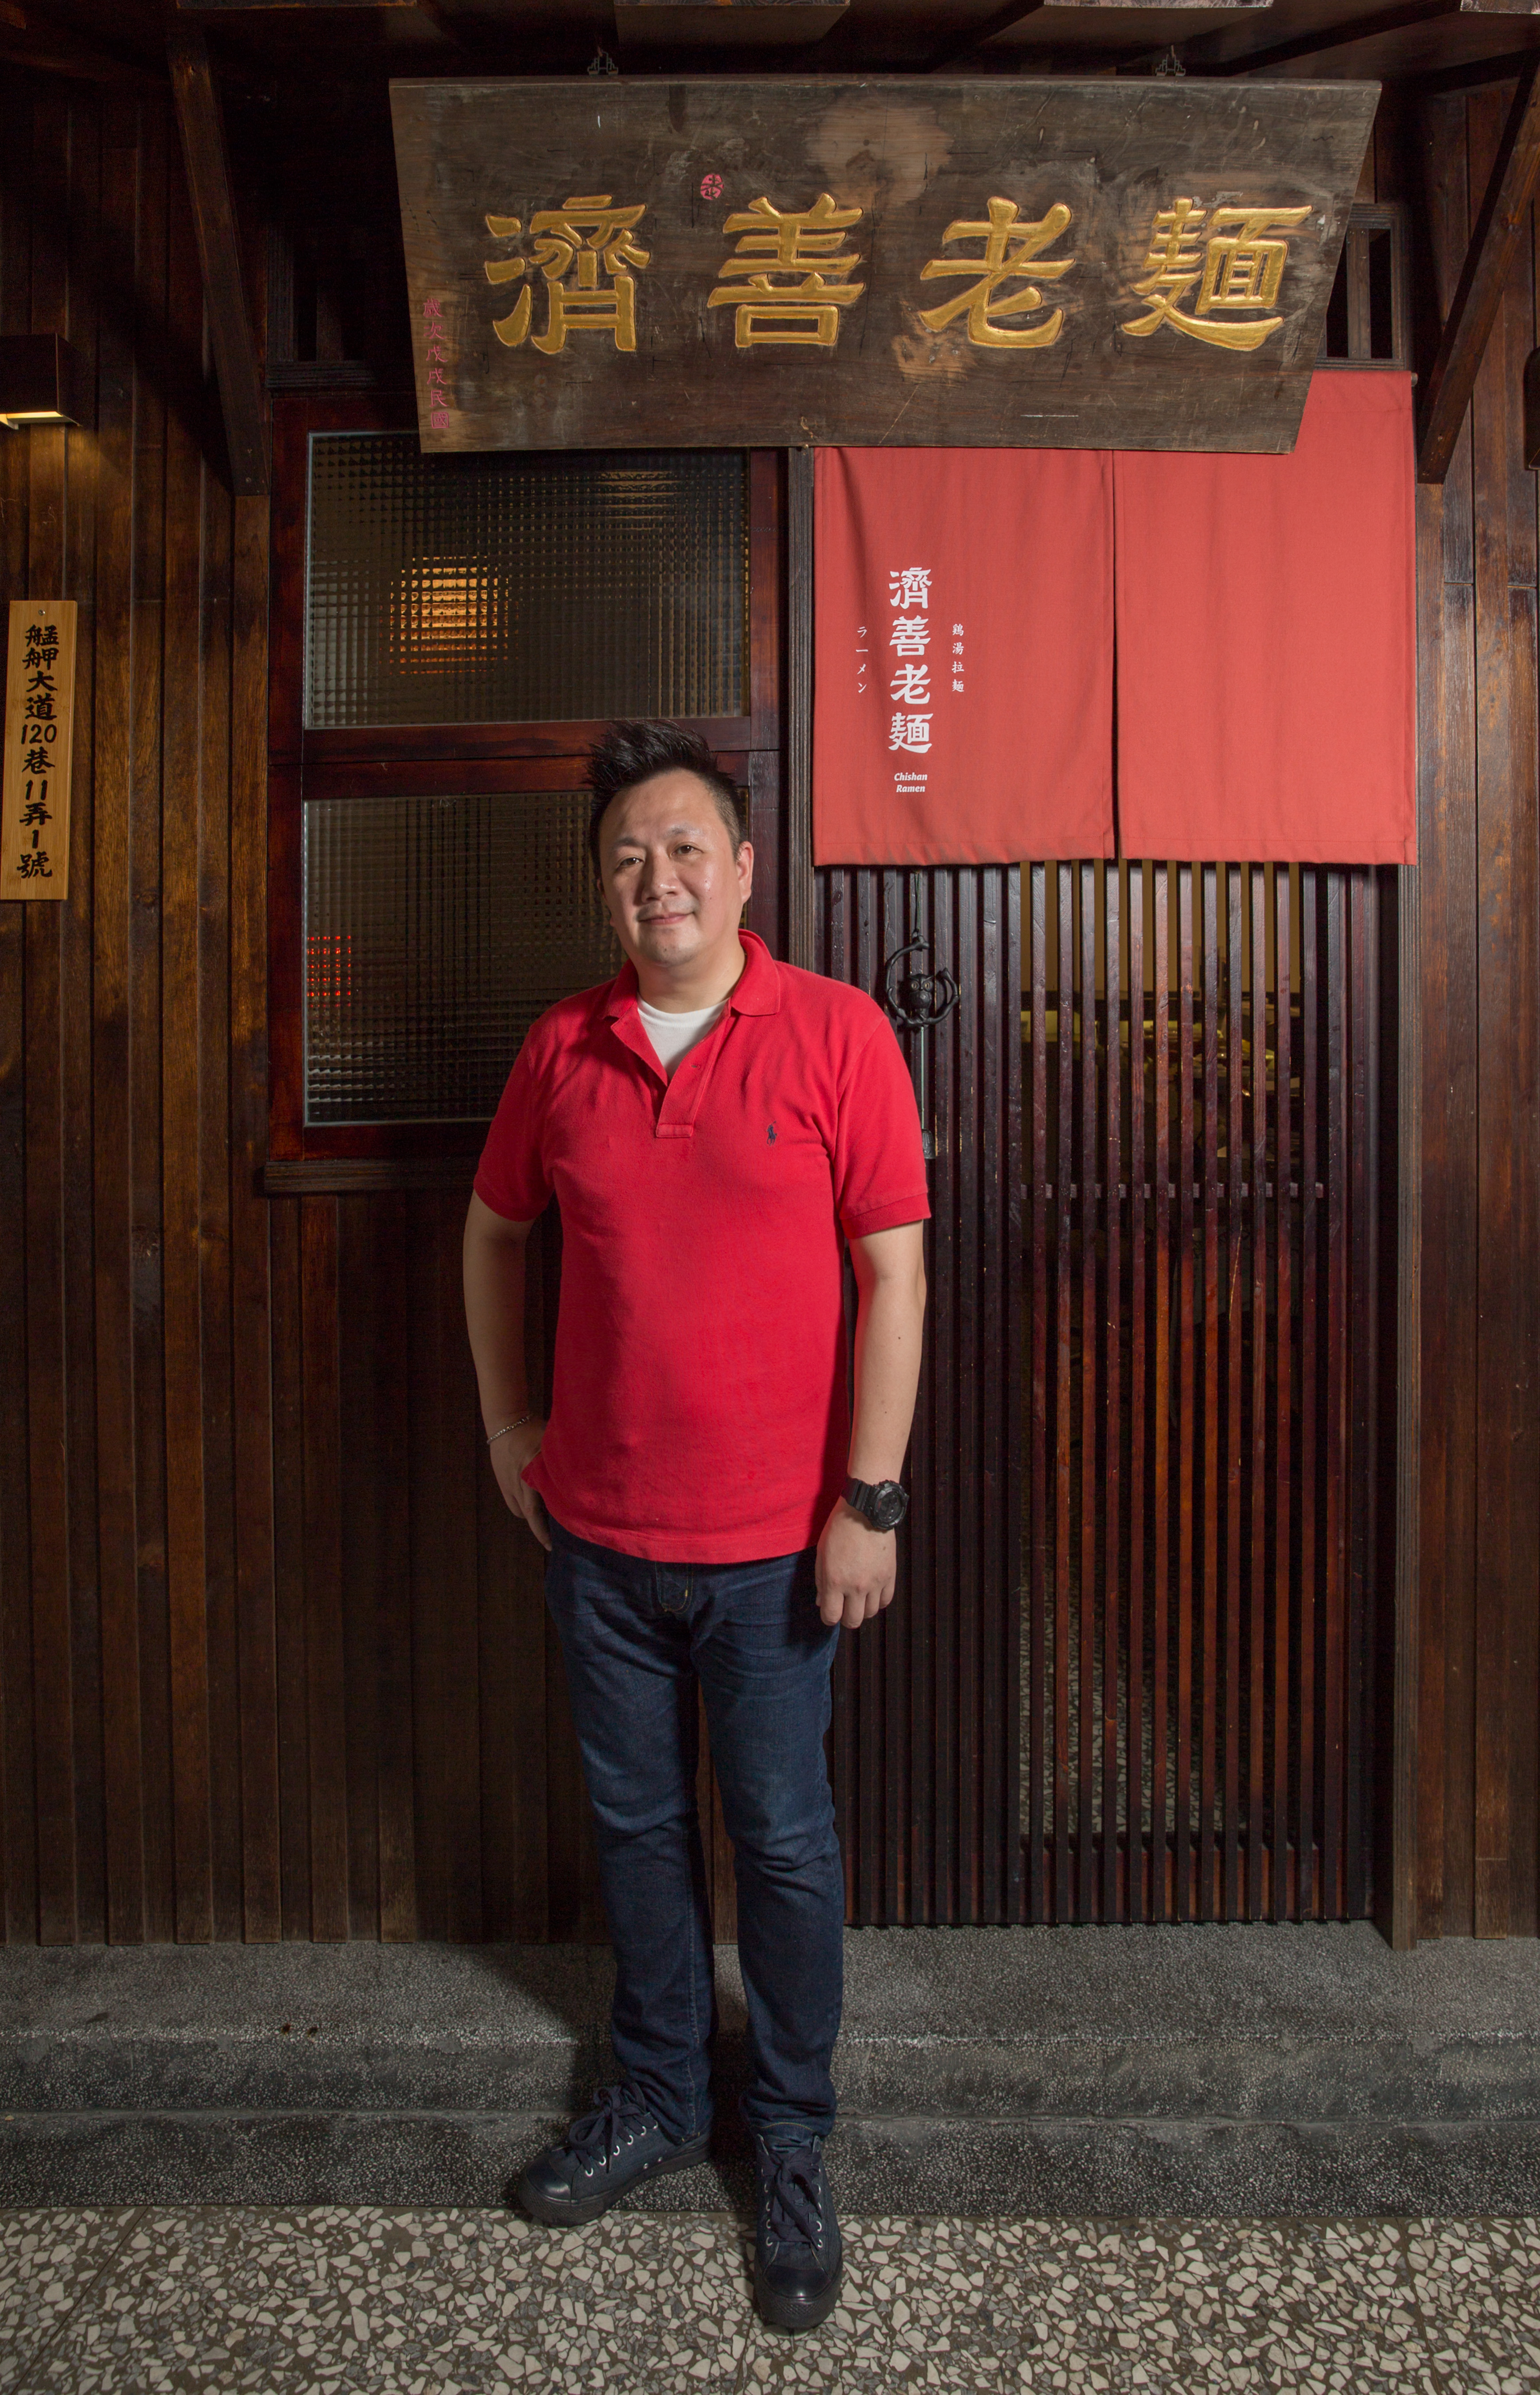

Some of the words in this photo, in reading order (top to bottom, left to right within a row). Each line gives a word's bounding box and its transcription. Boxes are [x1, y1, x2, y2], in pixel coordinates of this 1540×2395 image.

[856, 626, 868, 693] ラーメン
[16, 624, 59, 879] 艋舺大道120巷11弄1號
[894, 772, 928, 781] Chishan
[896, 784, 926, 793] Ramen
